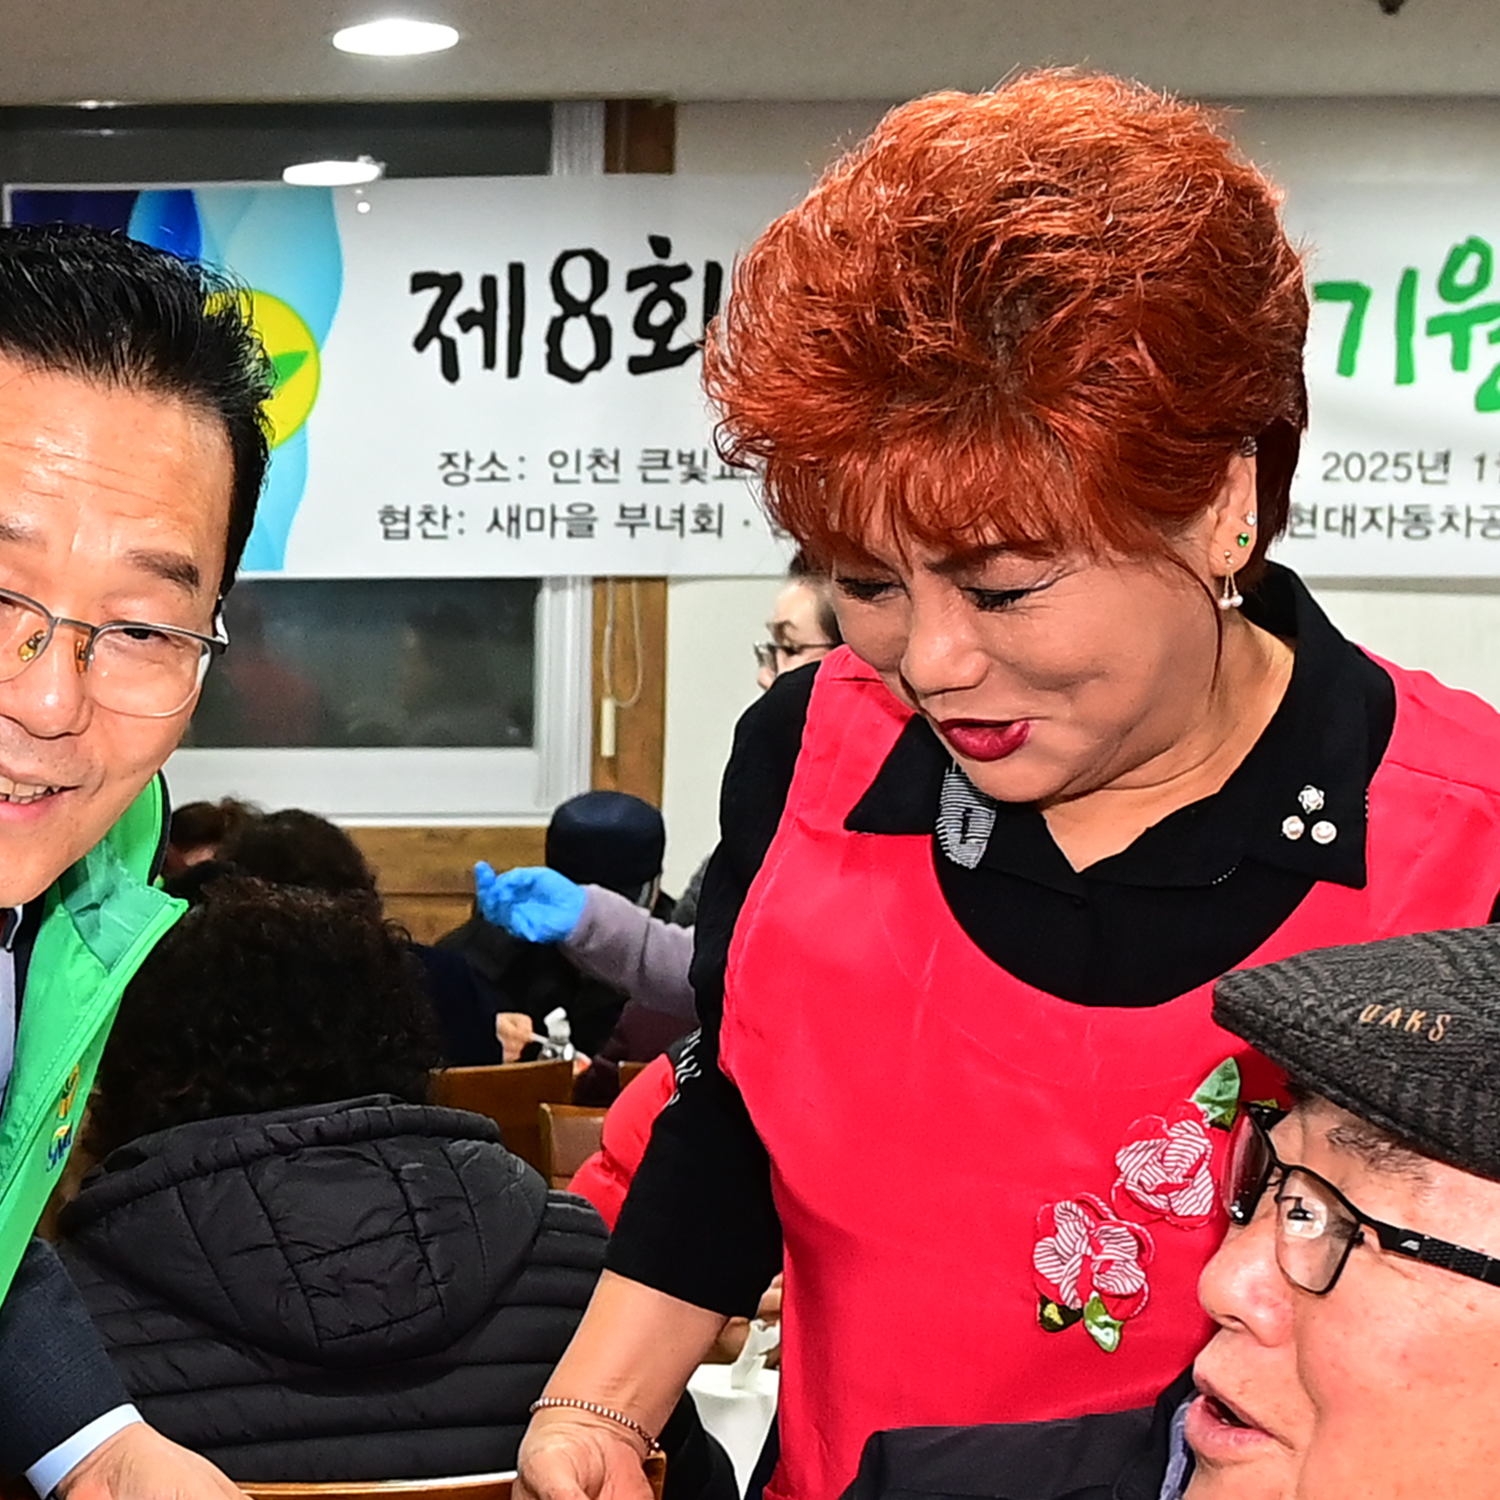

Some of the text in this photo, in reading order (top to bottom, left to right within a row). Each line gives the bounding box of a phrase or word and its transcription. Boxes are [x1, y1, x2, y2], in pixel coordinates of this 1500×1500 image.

[410, 235, 723, 384] 제8회
[437, 449, 525, 487] 장소:
[547, 448, 621, 484] 인천
[1321, 449, 1452, 486] 2025년
[377, 503, 465, 541] 협찬:
[485, 501, 598, 540] 새마을
[614, 500, 724, 540] 부녀회
